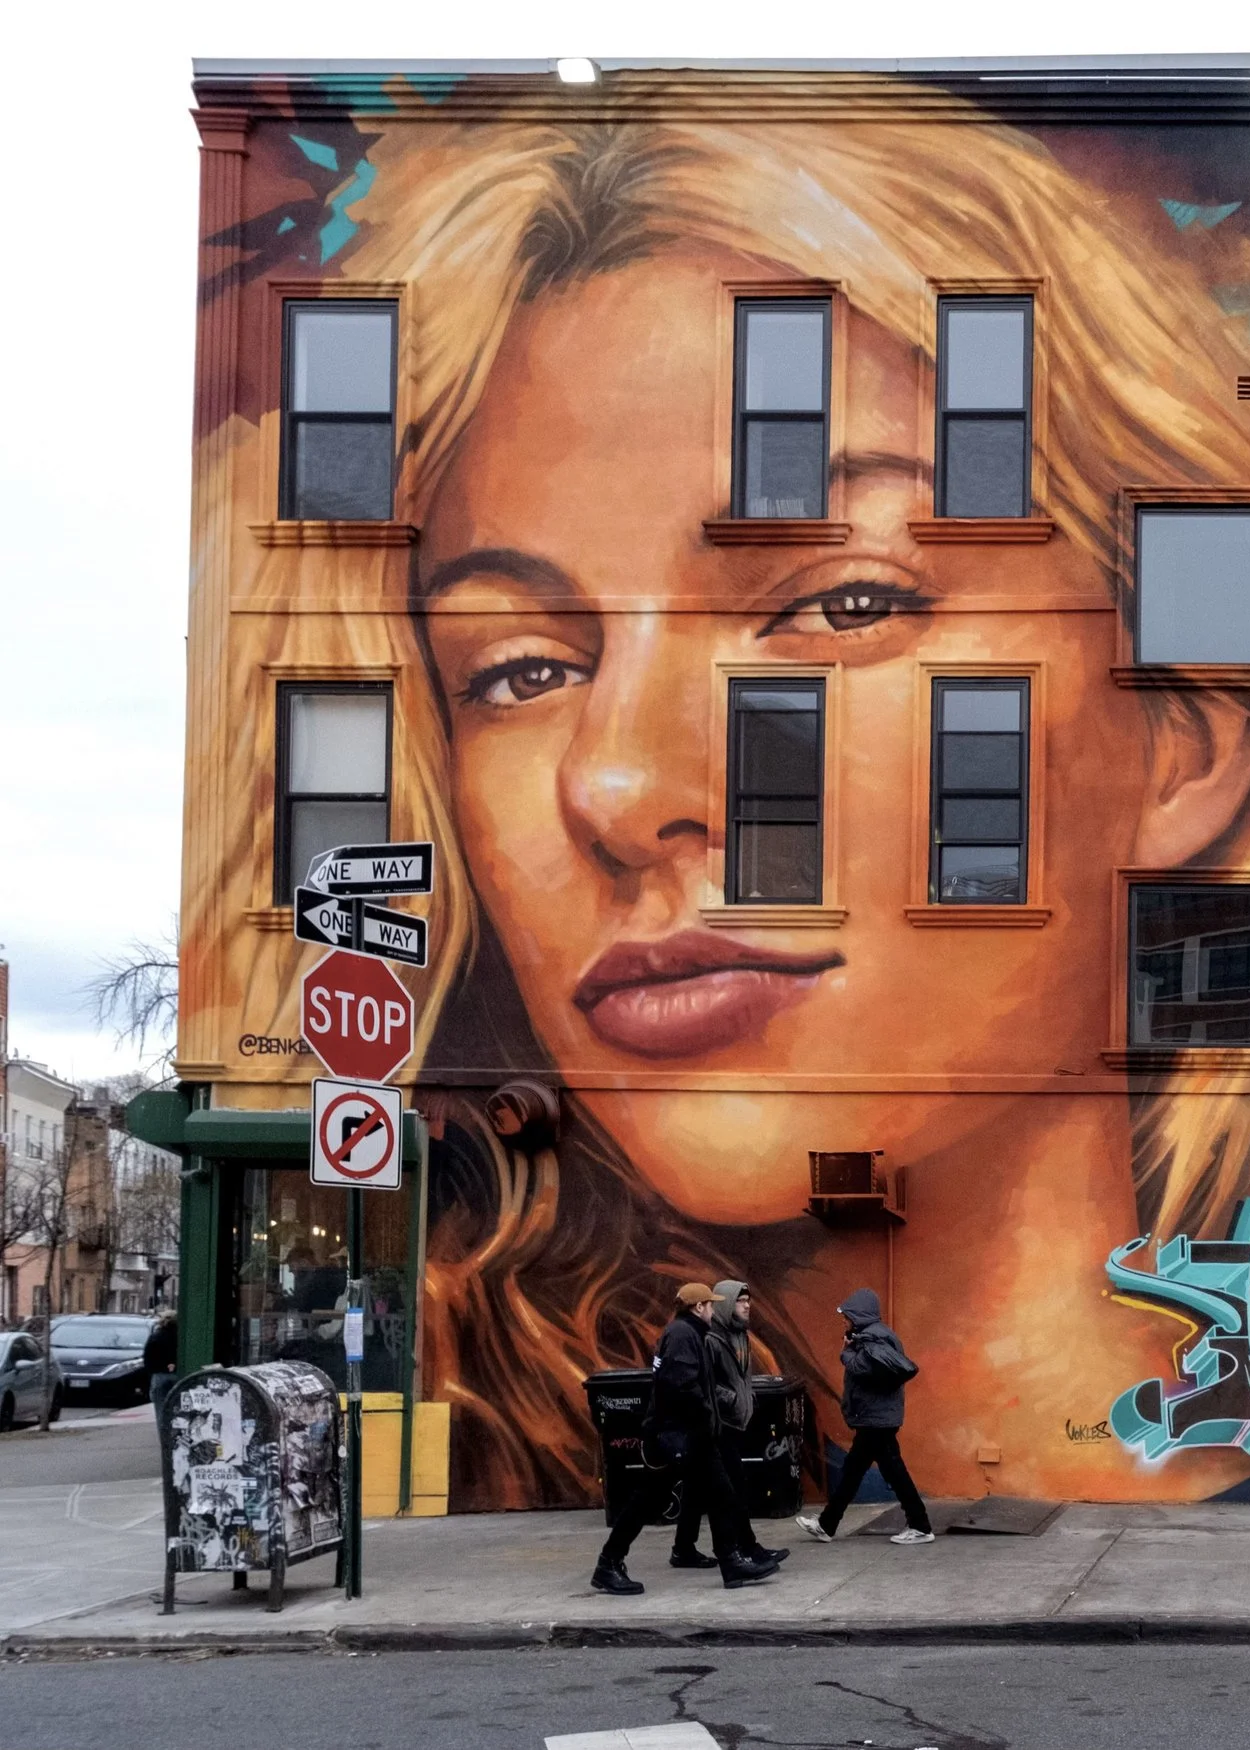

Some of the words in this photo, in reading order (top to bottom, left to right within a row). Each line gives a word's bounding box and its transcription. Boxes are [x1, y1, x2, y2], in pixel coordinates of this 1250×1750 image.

[317, 862, 351, 882] ONE
[372, 859, 414, 880] WAY
[319, 909, 353, 935] ONE
[379, 923, 413, 949] WAY
[309, 985, 406, 1045] STOP
